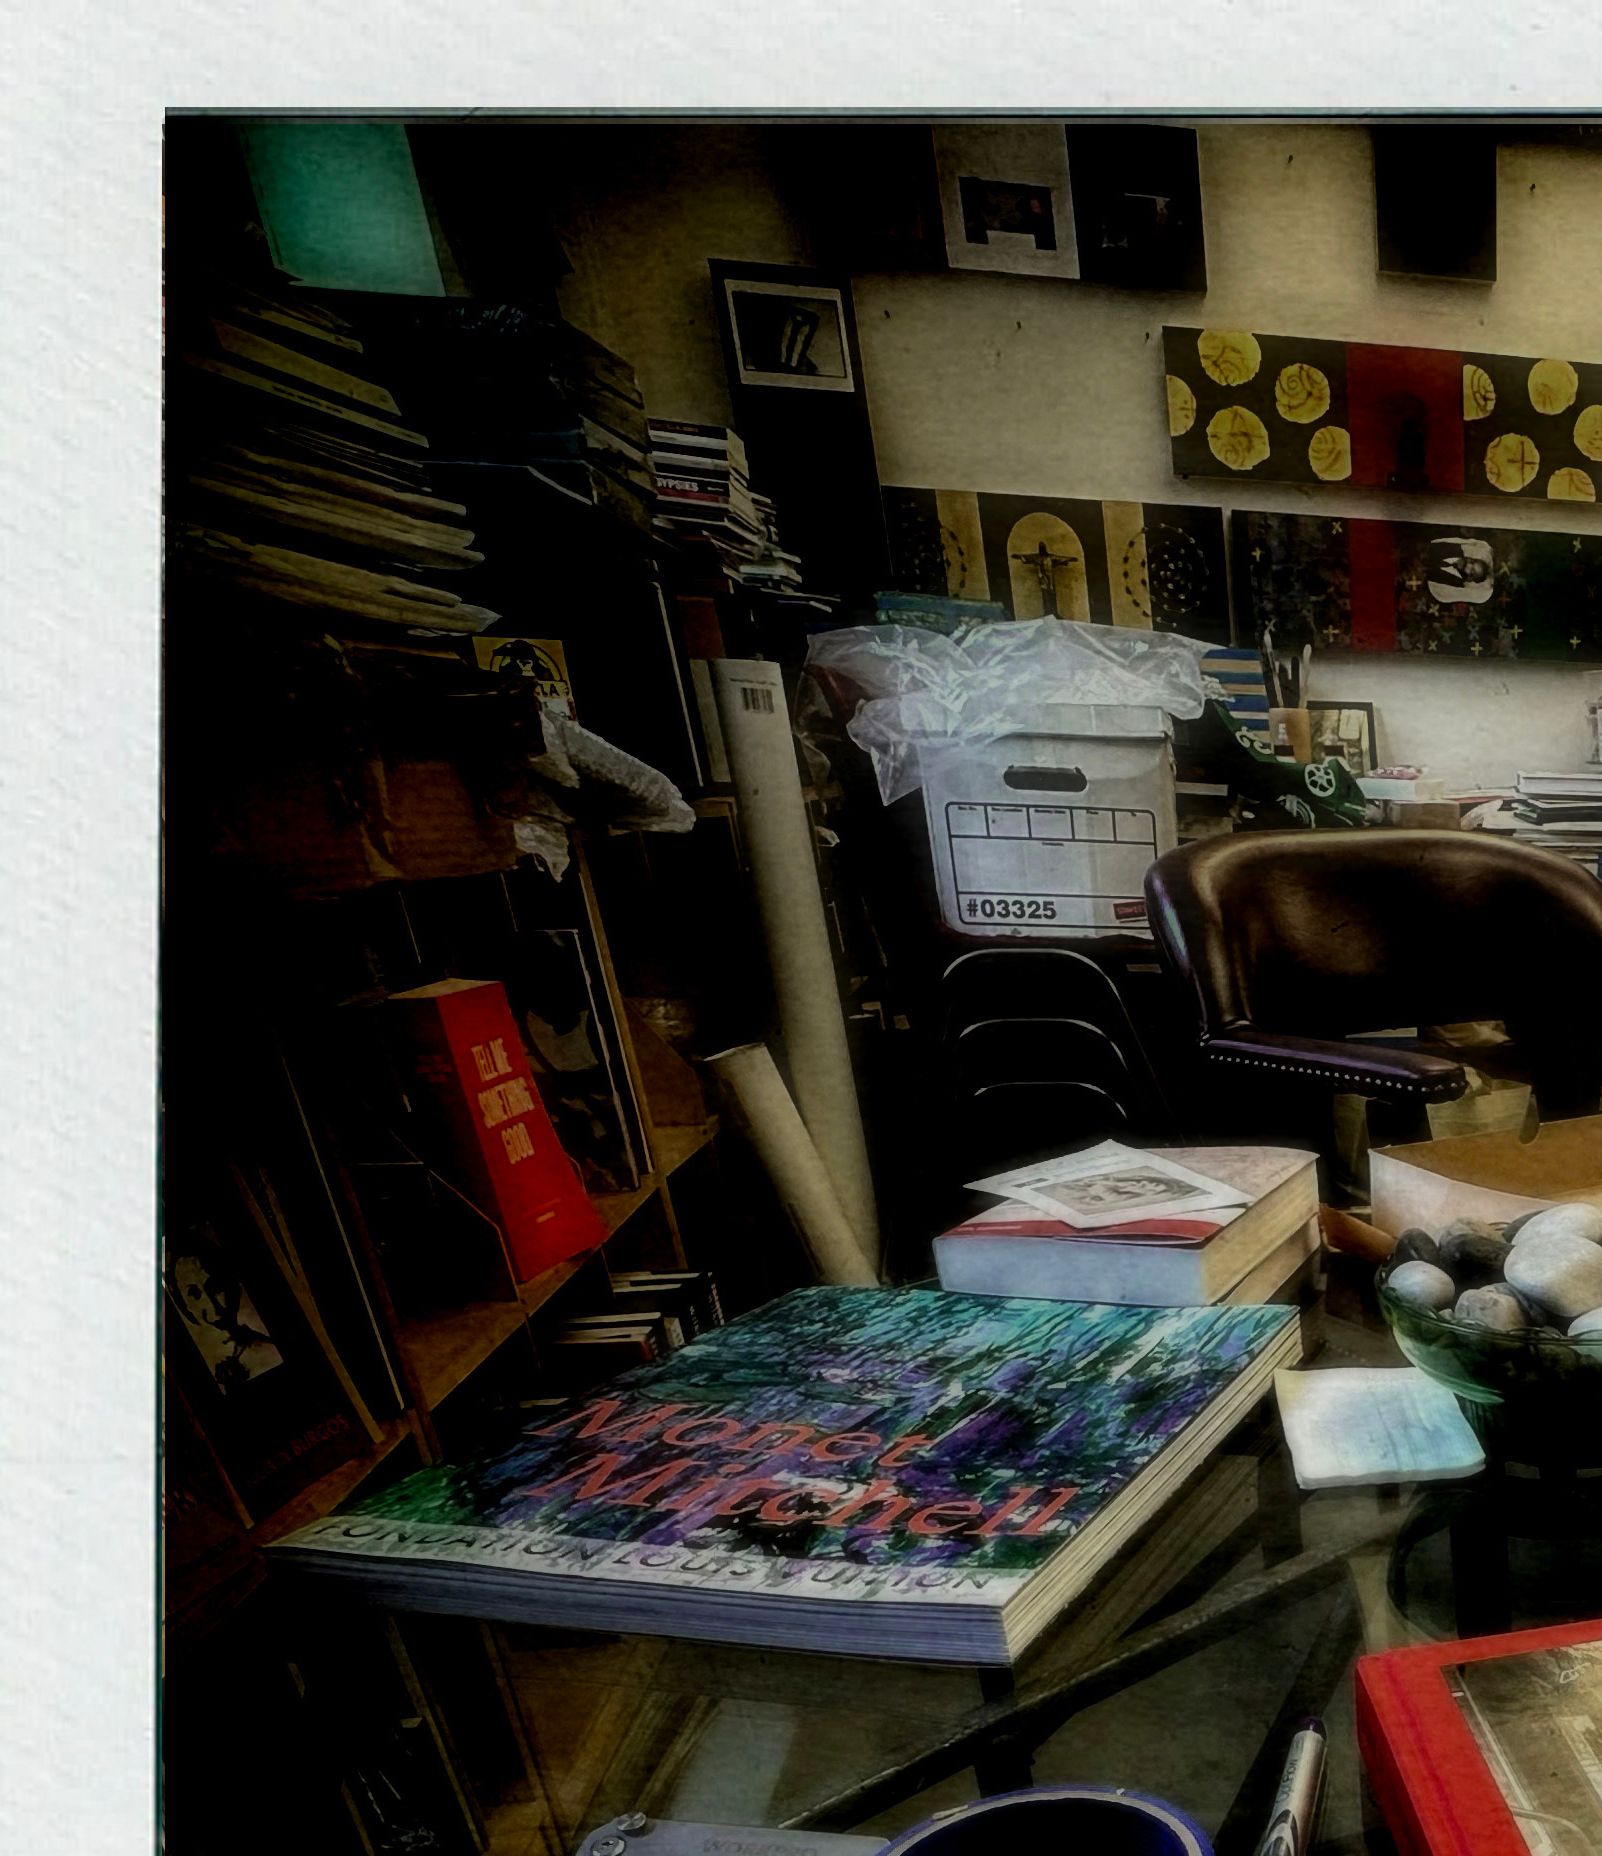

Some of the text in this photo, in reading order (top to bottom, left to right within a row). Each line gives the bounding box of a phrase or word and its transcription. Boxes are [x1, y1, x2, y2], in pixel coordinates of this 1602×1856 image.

[967, 899, 1056, 919] #03325
[522, 1397, 936, 1468] Monet
[520, 1452, 1081, 1536] Mitchell
